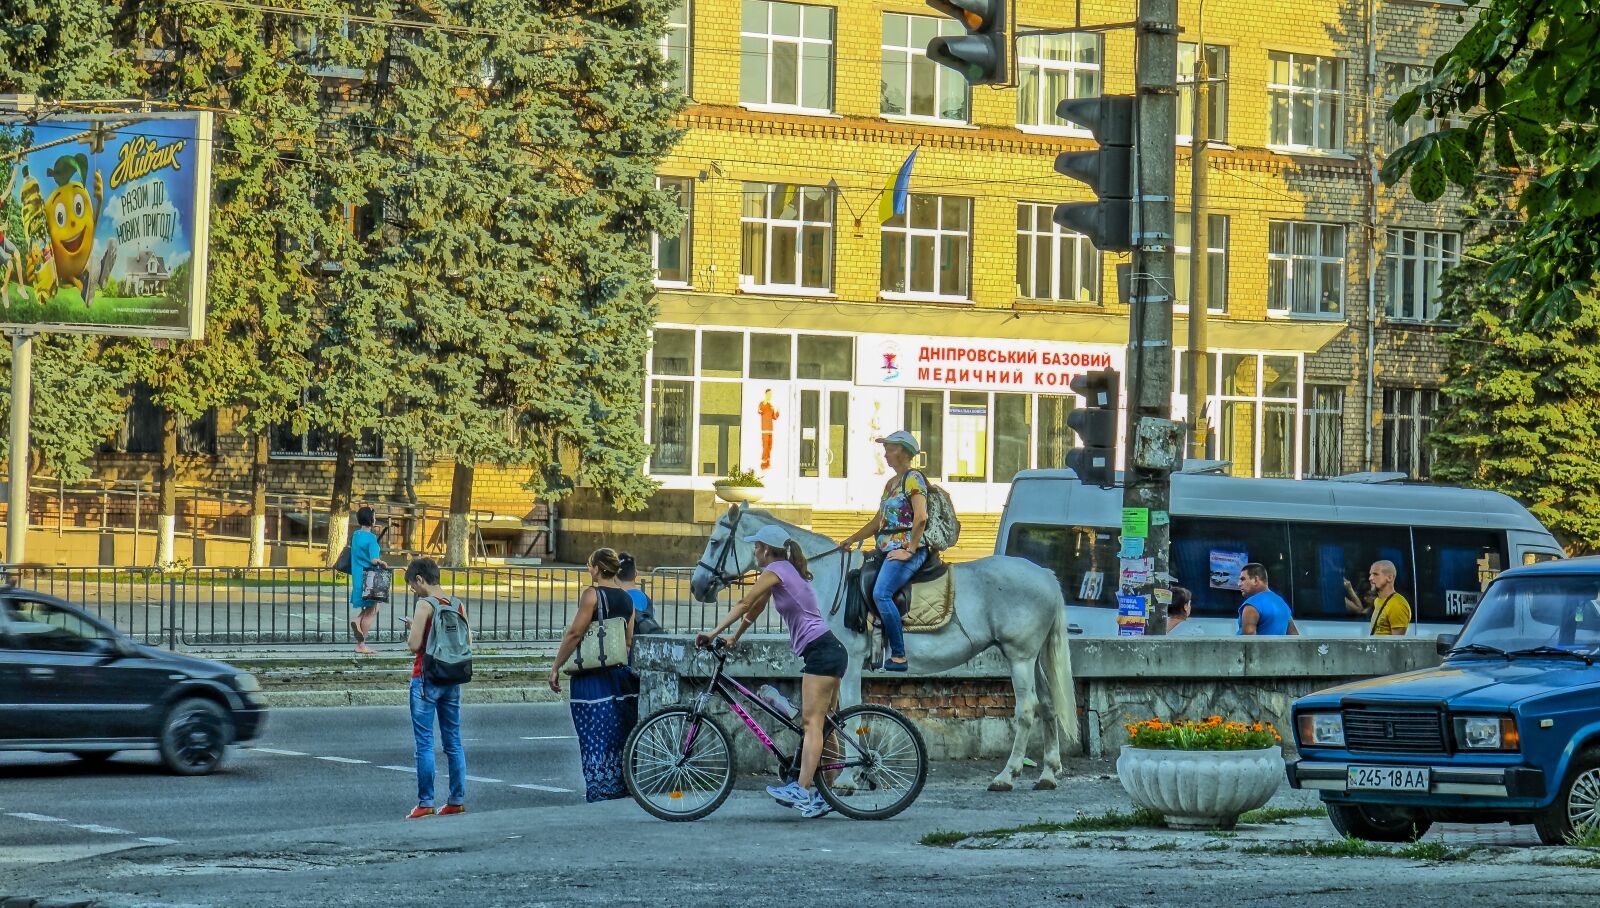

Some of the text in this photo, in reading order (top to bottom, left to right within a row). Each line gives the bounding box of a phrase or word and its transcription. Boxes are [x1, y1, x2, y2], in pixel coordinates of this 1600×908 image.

[110, 135, 184, 190] Живчик
[121, 181, 164, 217] РАЗОМ ДО
[116, 211, 177, 246] НОВИХ ПРИГОД!
[918, 346, 1112, 367] ДНІПРОВСЬКИЙ БАЗОВИЙ
[918, 367, 1081, 386] МЕДИЧНИЙ КОЛ
[1447, 593, 1463, 615] 151
